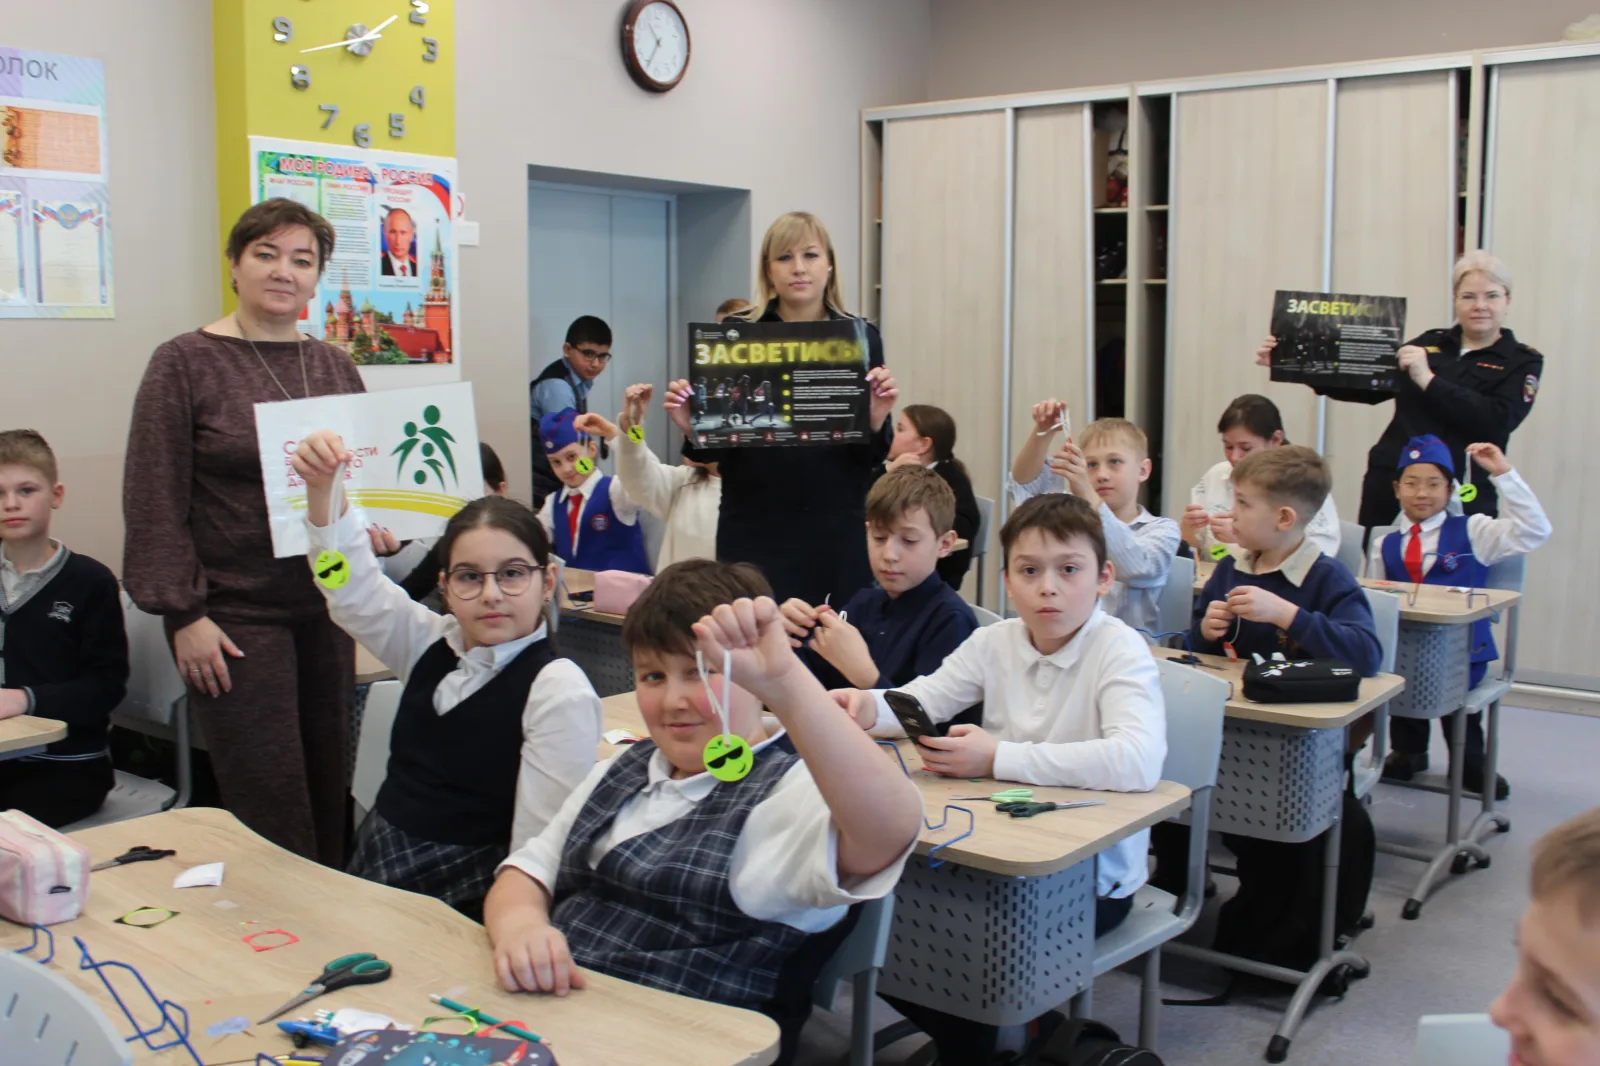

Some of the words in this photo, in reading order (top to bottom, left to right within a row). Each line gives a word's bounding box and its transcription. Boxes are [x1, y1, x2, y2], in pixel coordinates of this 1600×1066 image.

[273, 16, 293, 43] 9
[422, 37, 439, 62] 3
[291, 64, 311, 90] 8
[409, 85, 426, 109] 4
[319, 104, 340, 129] 7
[388, 113, 406, 137] 5
[353, 123, 373, 148] 6
[279, 157, 313, 173] МОЯ
[316, 161, 370, 180] РОДИНА
[381, 168, 433, 185] РОССИЯ
